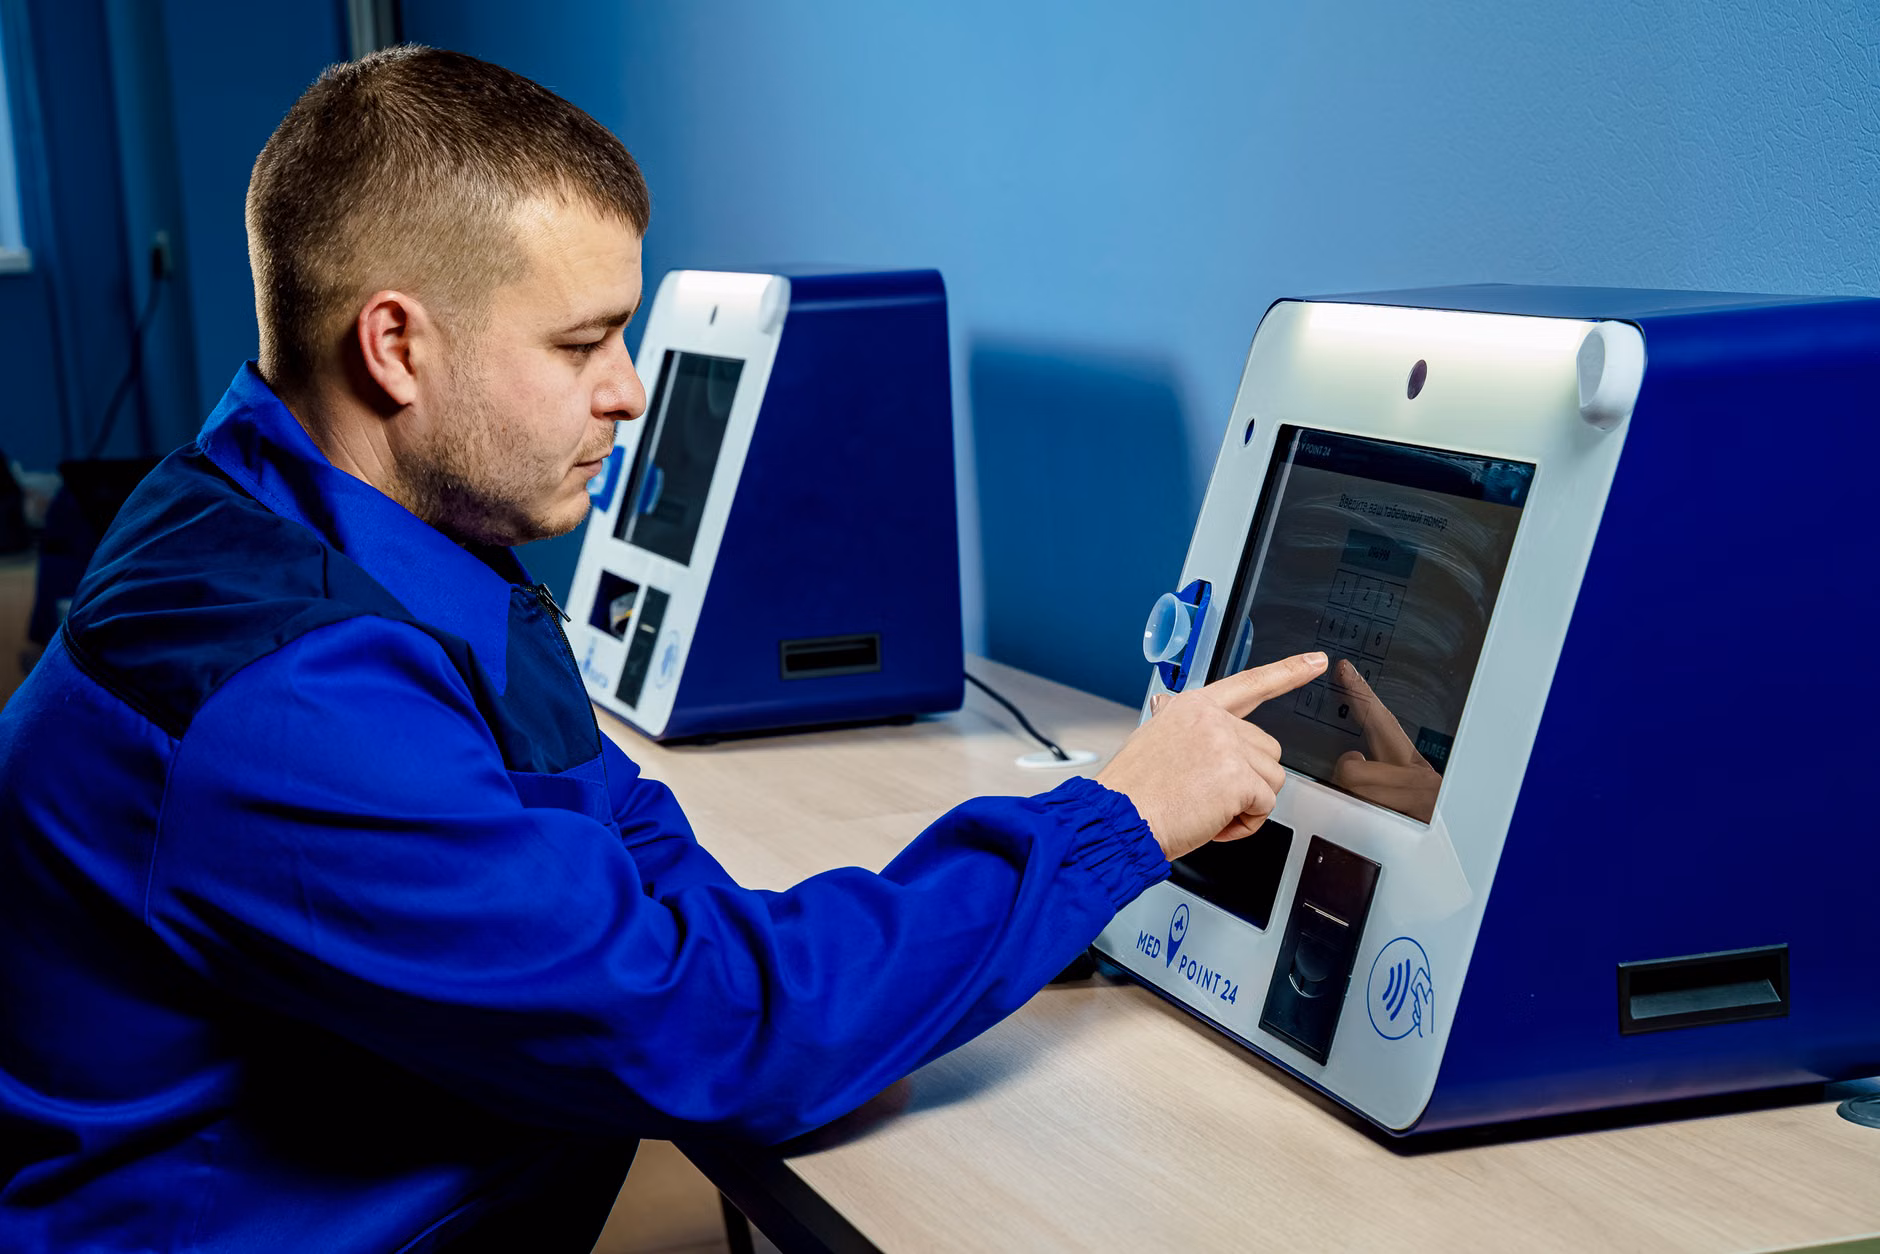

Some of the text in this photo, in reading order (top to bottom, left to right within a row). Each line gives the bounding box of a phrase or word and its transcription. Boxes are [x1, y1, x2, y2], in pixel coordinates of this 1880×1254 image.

[1339, 493, 1448, 532] Введите ваш табельный номер
[1363, 586, 1371, 601] 2
[1386, 593, 1394, 608] 3
[1328, 618, 1383, 646] 4 5 6
[1305, 691, 1313, 706] 0
[1418, 739, 1447, 760] ДАЛЕЕ
[1136, 930, 1239, 1005] MED POINT 24
